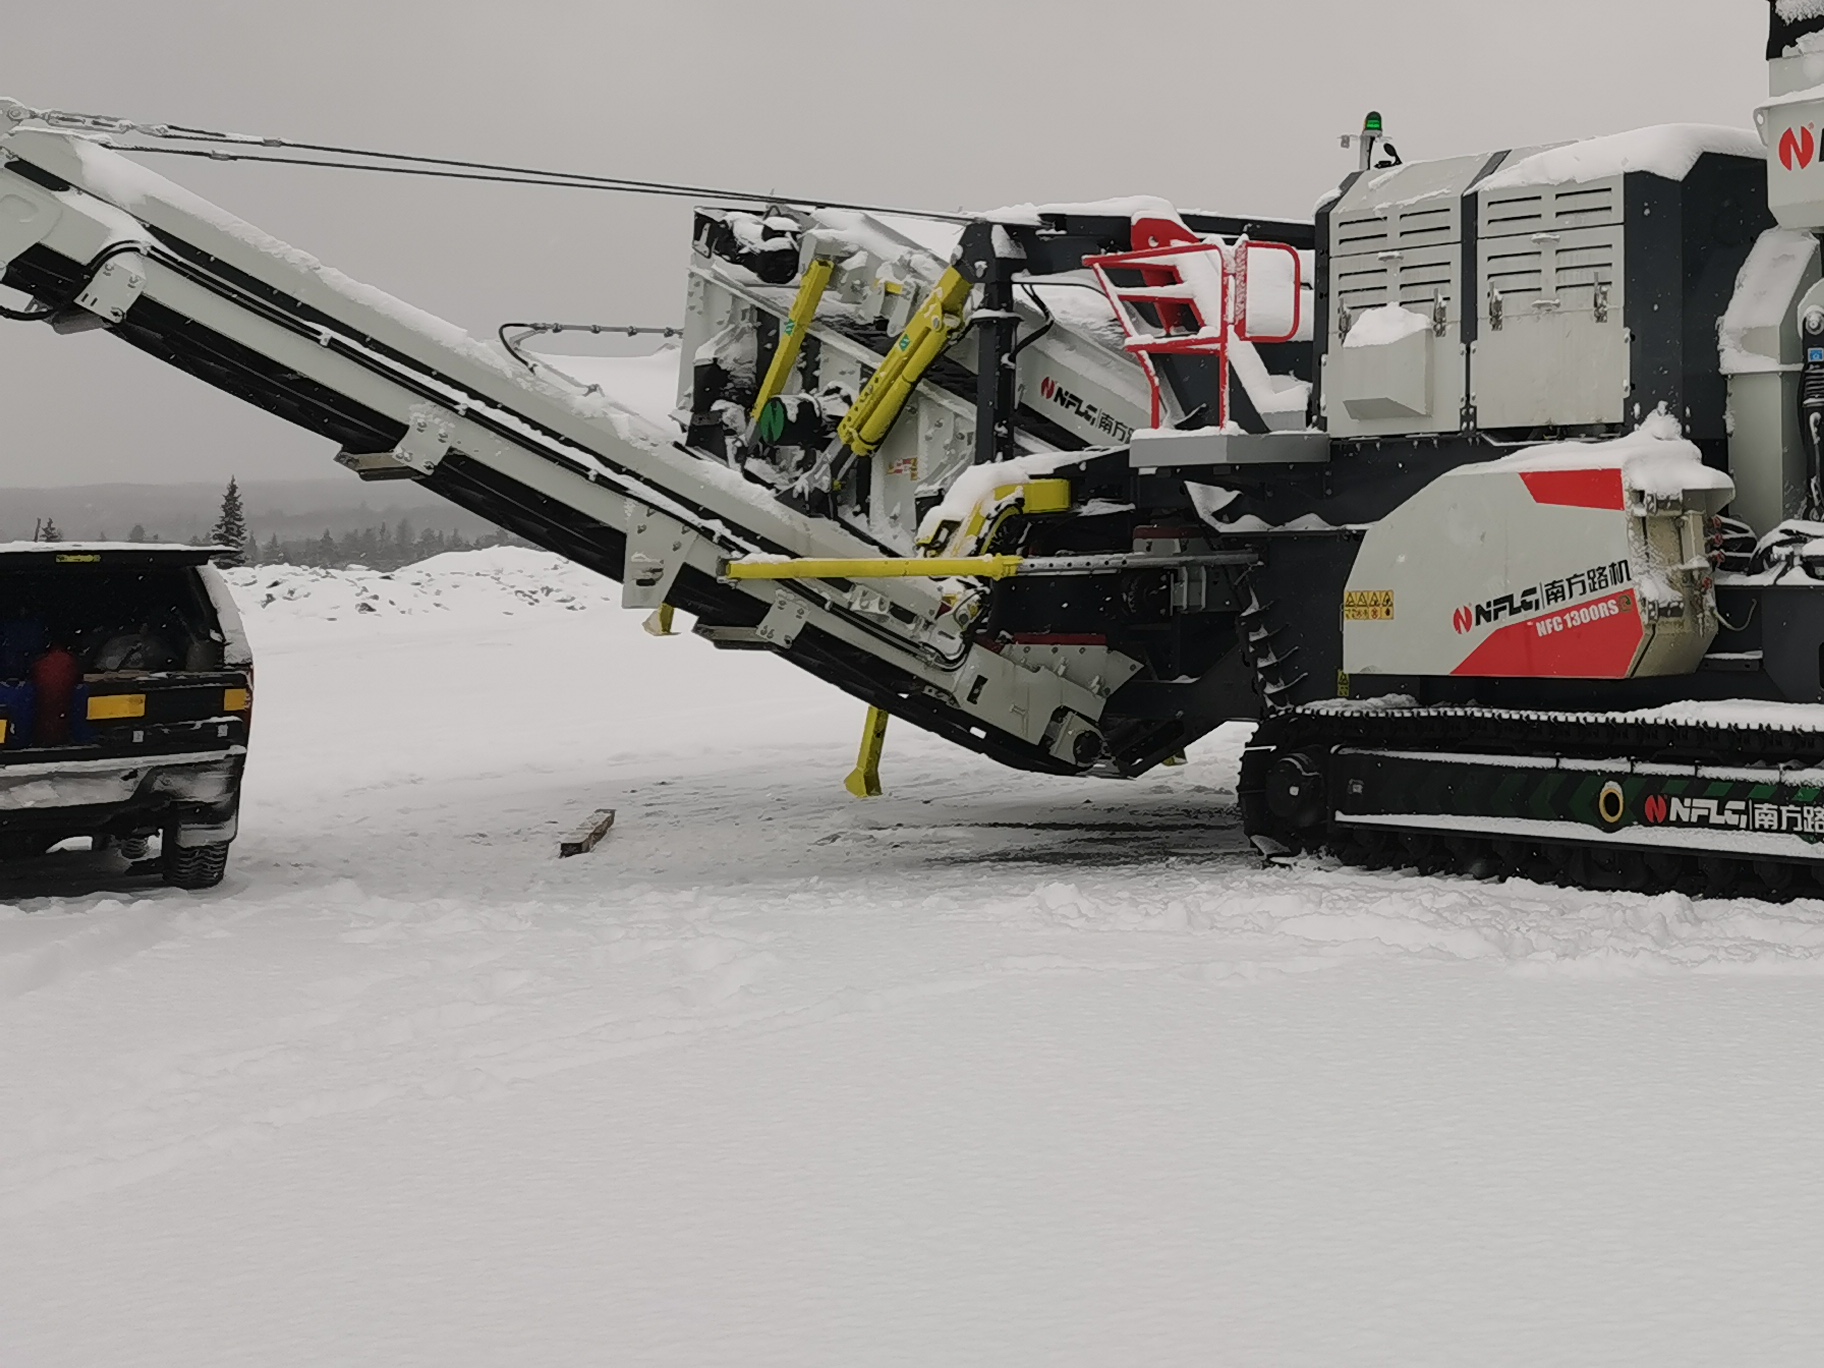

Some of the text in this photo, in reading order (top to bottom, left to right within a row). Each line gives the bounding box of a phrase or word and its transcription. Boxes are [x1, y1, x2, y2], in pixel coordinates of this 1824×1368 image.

[1544, 559, 1632, 606] 南方路机
[1535, 599, 1619, 637] NFC 1300RS
